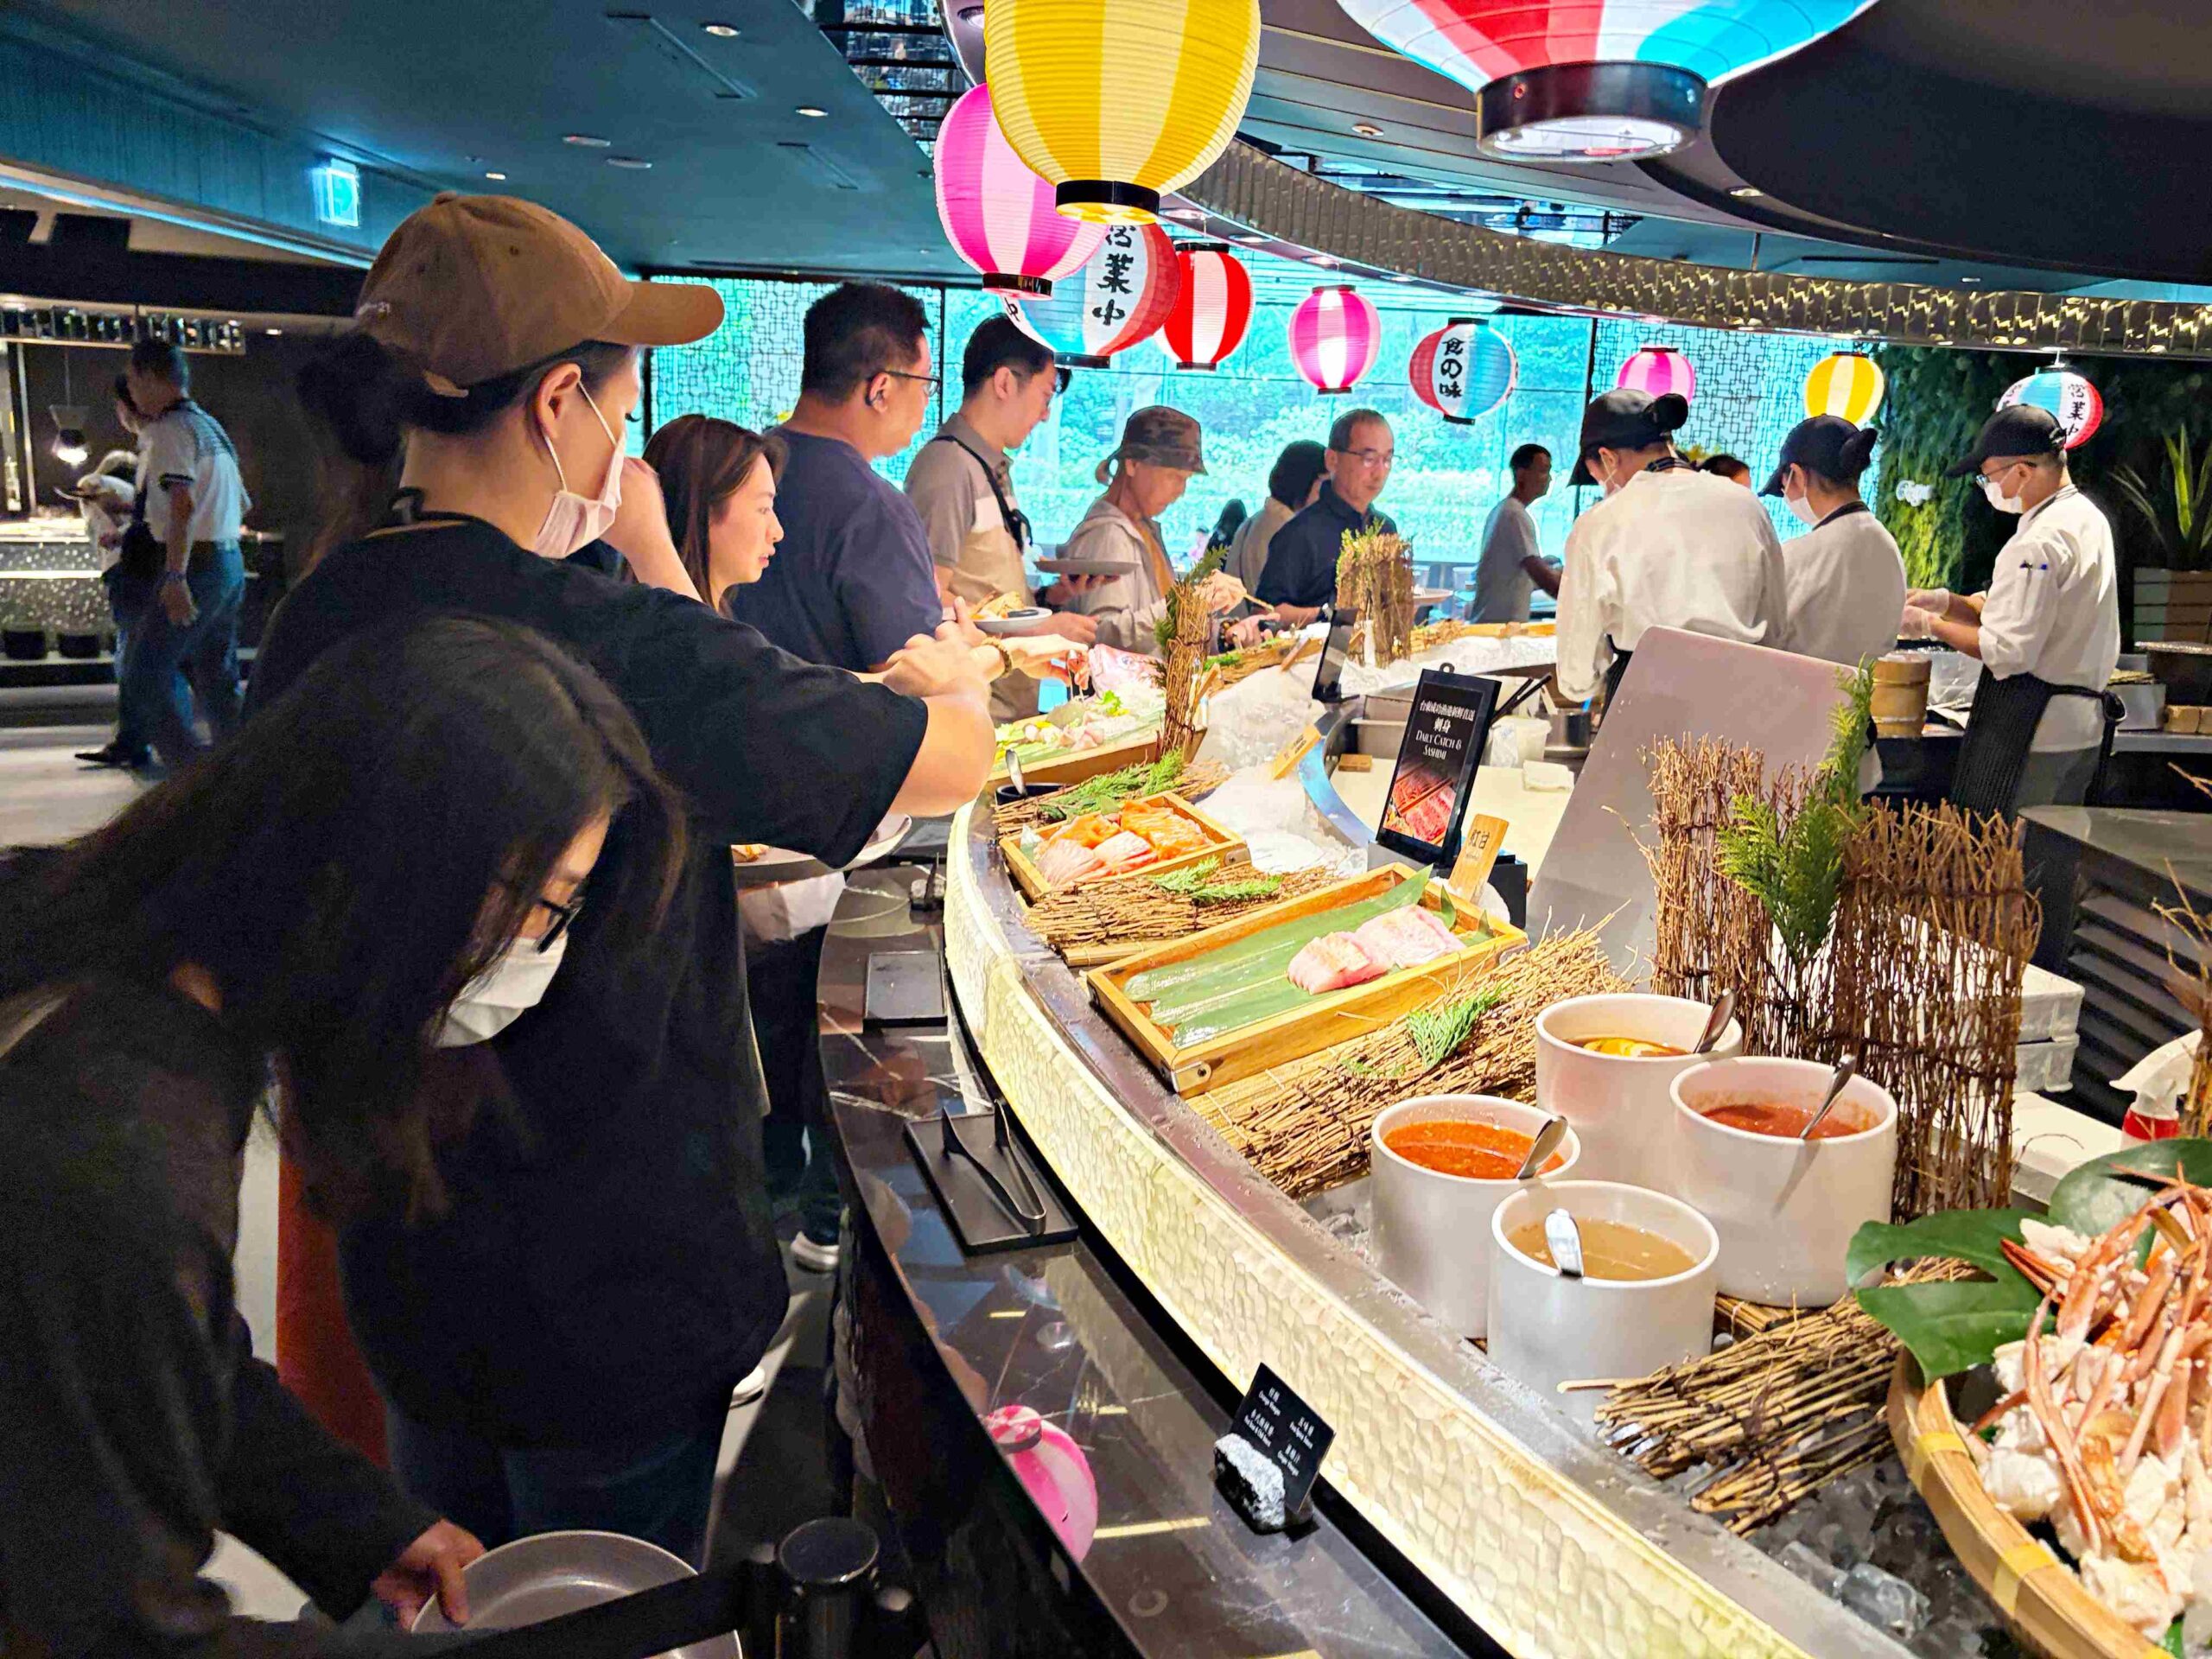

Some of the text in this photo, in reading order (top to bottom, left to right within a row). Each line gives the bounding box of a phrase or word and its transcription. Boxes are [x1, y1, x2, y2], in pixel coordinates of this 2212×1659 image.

[1439, 337, 1465, 398] 食の味
[1433, 717, 1452, 734] 刺身
